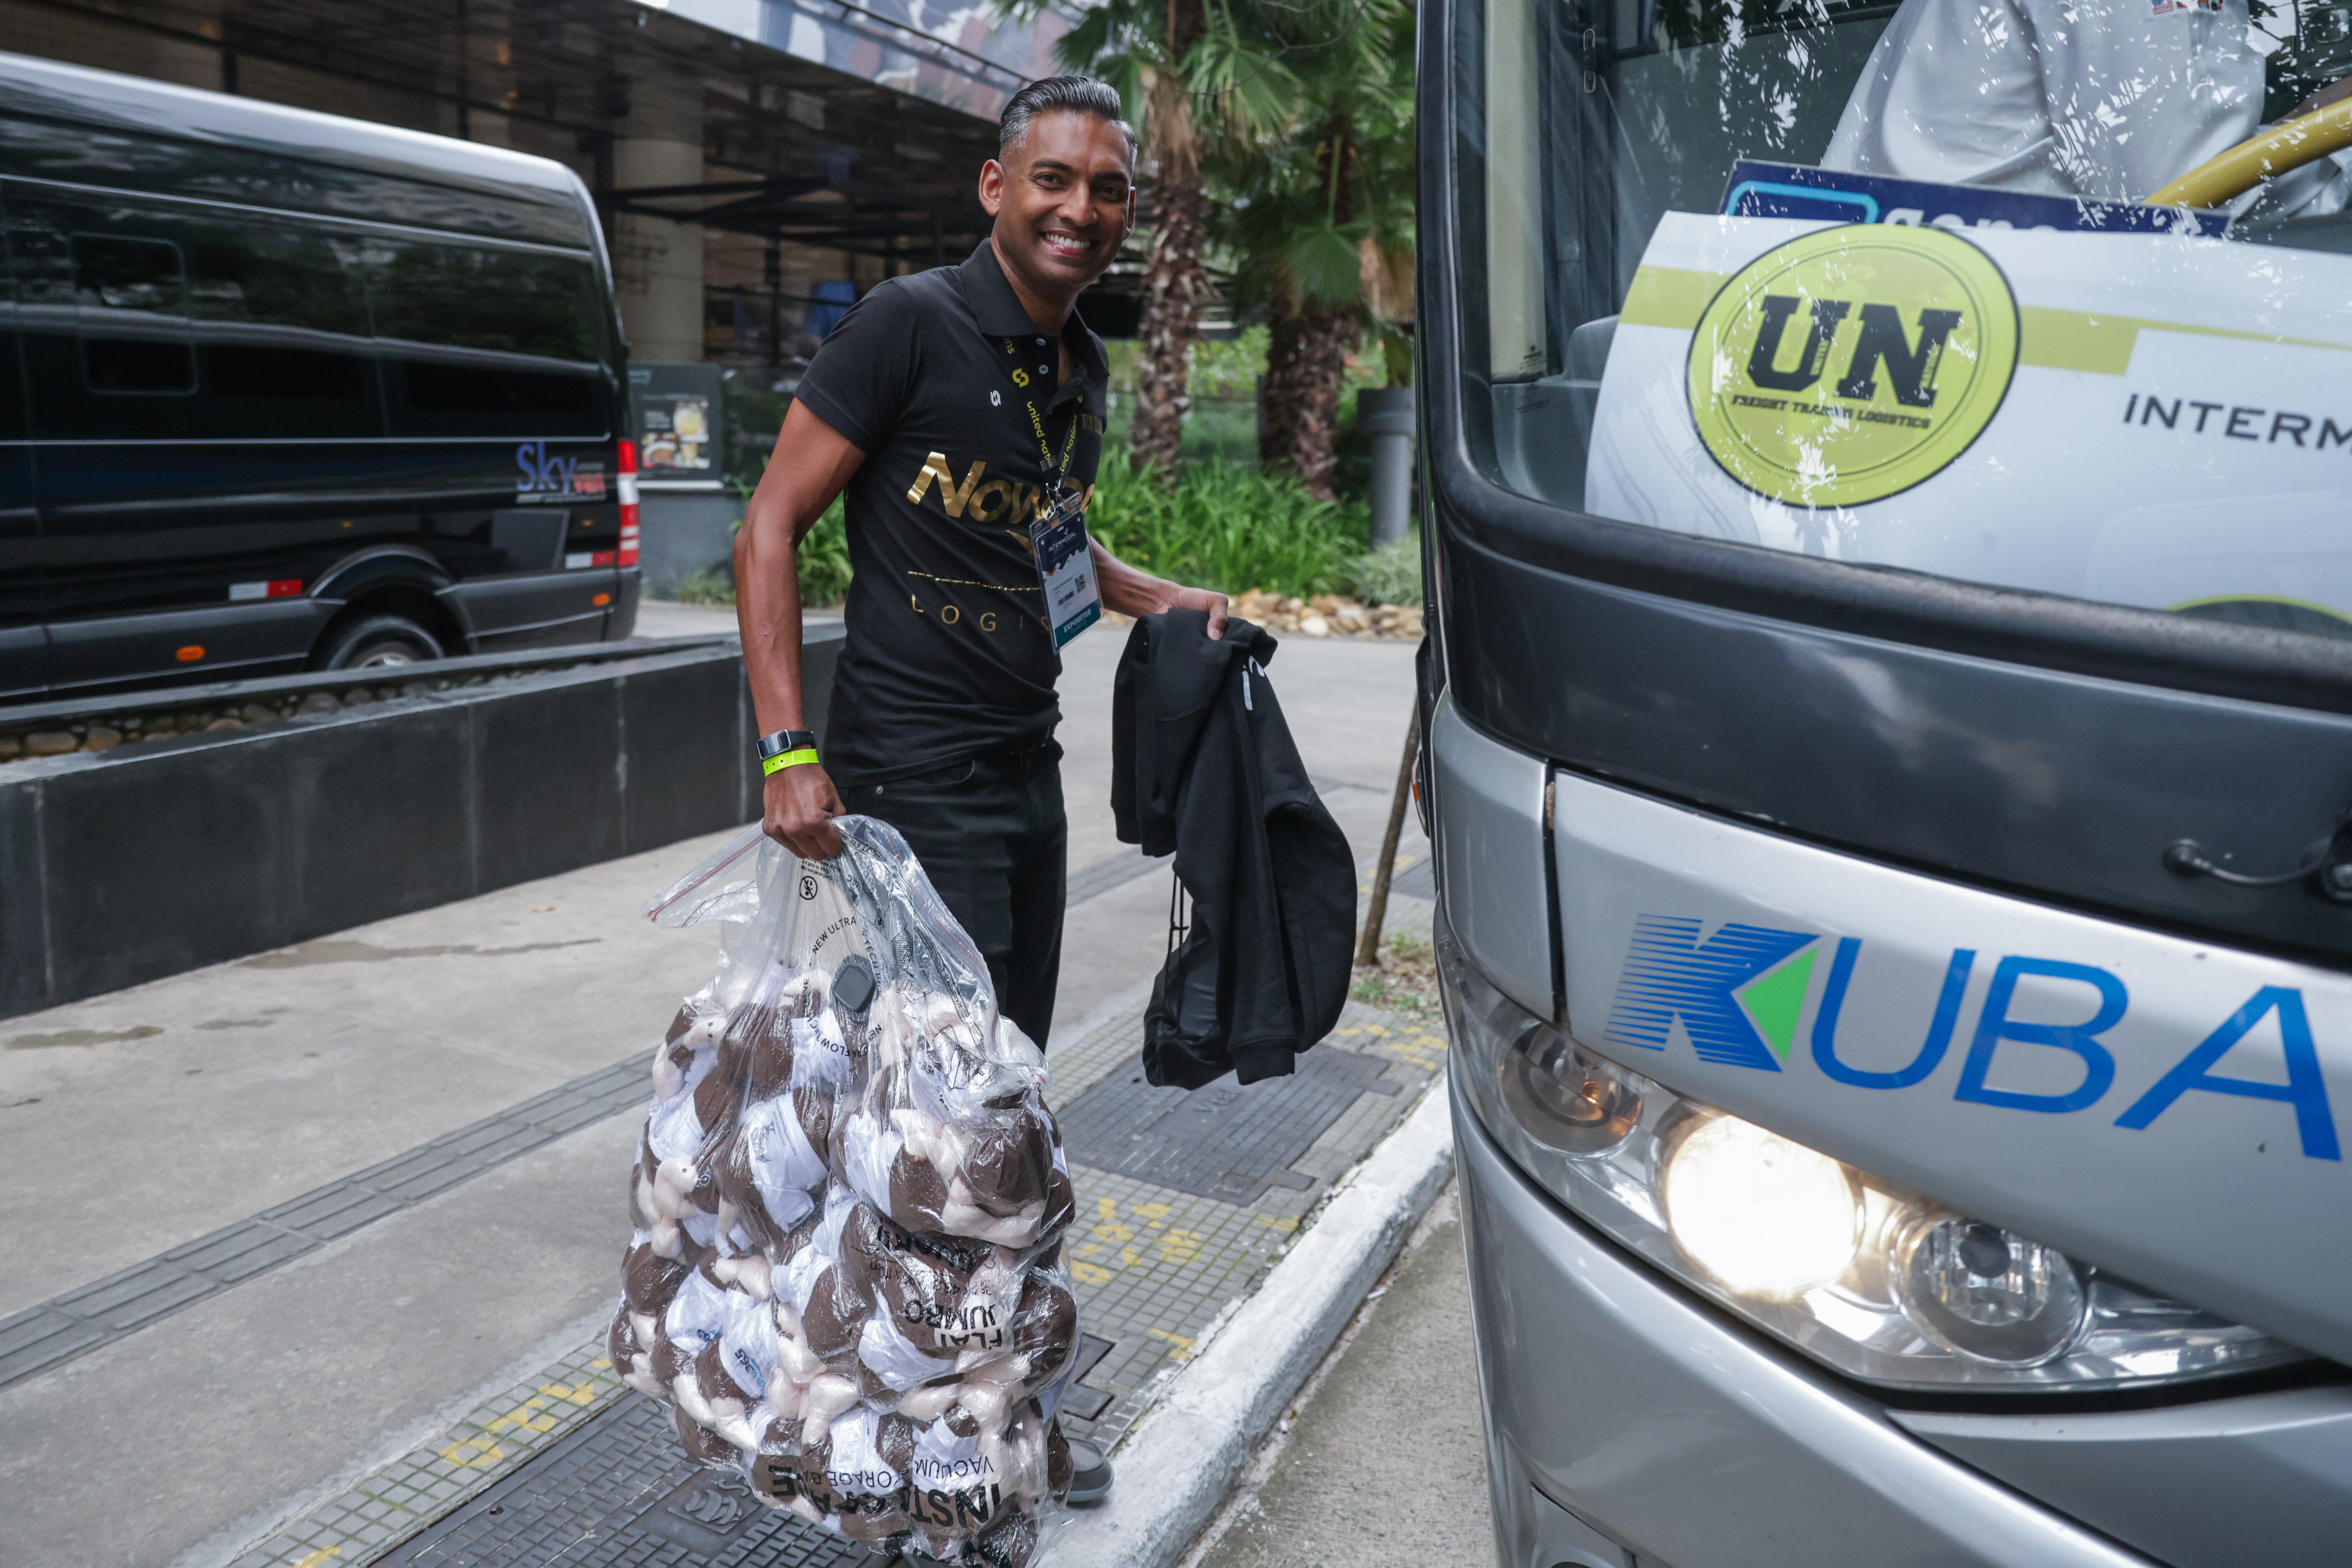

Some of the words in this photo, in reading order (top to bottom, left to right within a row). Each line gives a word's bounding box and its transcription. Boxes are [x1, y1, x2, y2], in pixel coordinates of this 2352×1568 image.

[1747, 294, 1963, 409] UN
[1732, 394, 1789, 412] FREIGHT
[1856, 409, 1932, 430] LOGISTICS
[516, 442, 578, 494] Sky
[1048, 531, 1077, 552] INTERMODAL
[1063, 608, 1092, 633] EXPOSITOR
[807, 868, 832, 881] Suffocation
[812, 931, 828, 955] NEW
[827, 916, 857, 934] ULTRA
[864, 939, 879, 969] TECH
[820, 1038, 850, 1057] FLOW
[1603, 912, 2342, 1162] KUBA
[904, 1299, 996, 1331] JUMBO
[800, 1468, 822, 1486] BA
[827, 1470, 902, 1490] ORAGE
[914, 1456, 994, 1480] VACUUM
